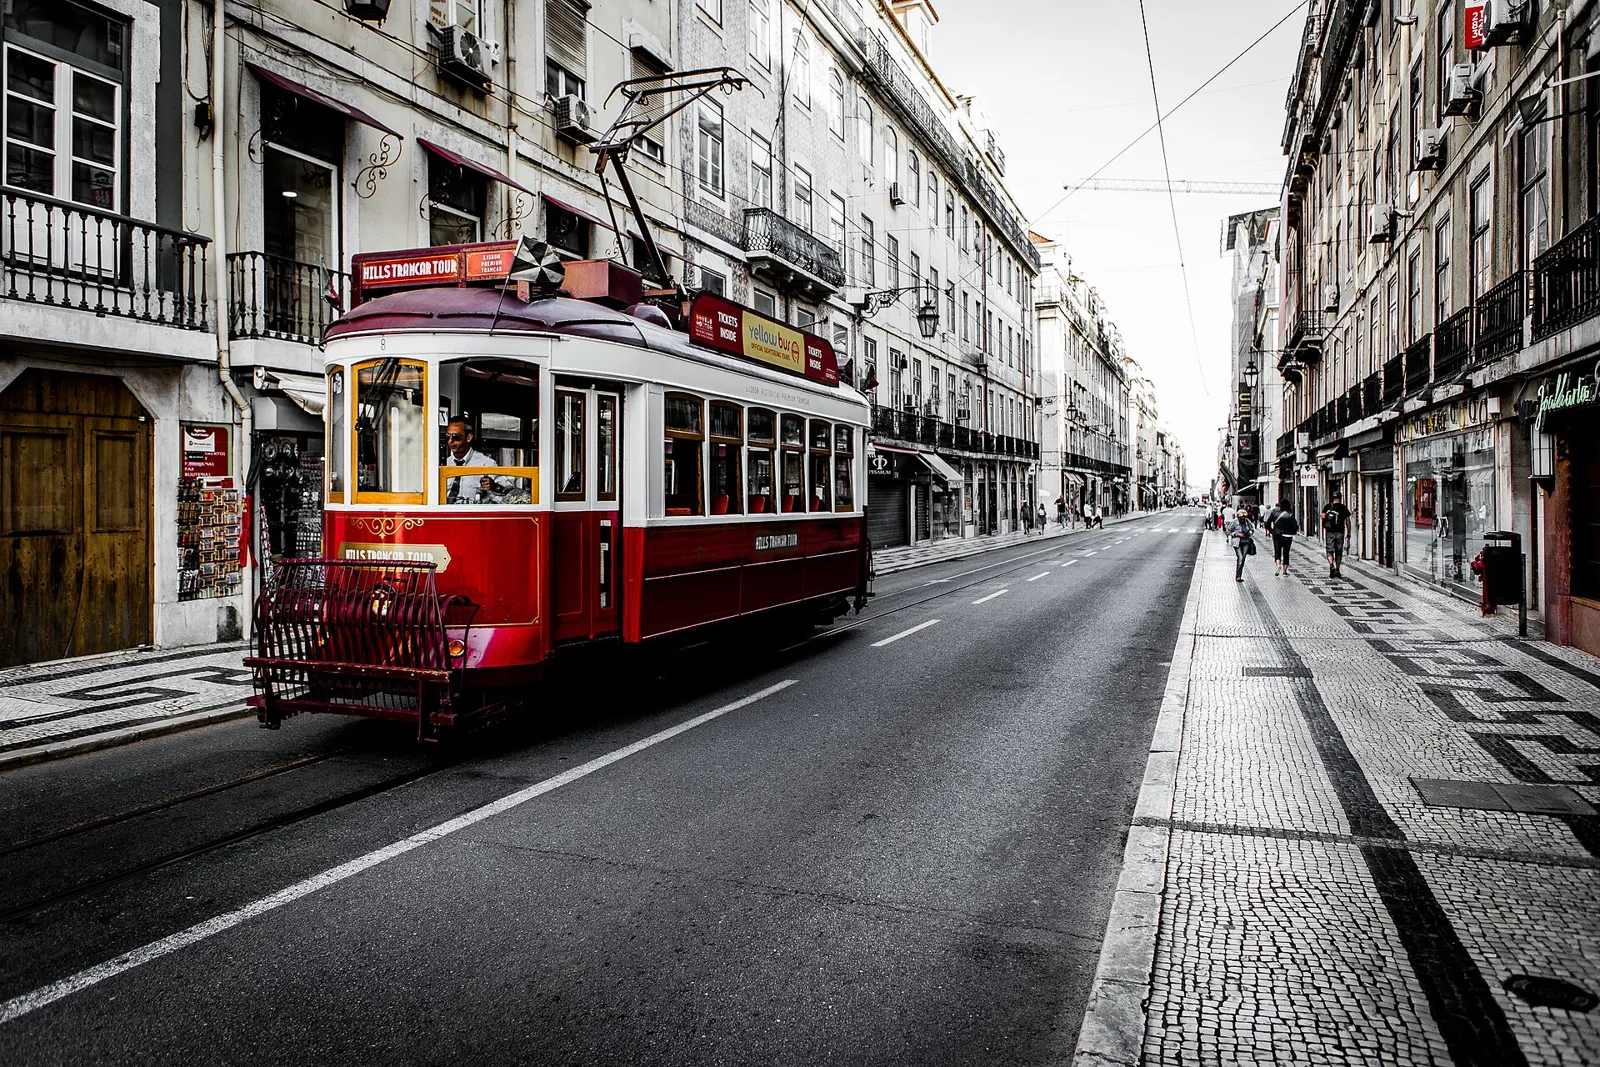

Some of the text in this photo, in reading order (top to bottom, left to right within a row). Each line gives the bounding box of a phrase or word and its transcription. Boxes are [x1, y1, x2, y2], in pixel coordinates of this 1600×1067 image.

[363, 259, 457, 280] HILLS TRAMCAR TOUR
[718, 311, 738, 328] TICKETS
[720, 327, 737, 342] INSIDE
[749, 324, 791, 351] yellow bus
[381, 338, 386, 351] 8
[751, 343, 764, 352] OFFICIAL
[808, 345, 822, 359] TICKETS
[810, 359, 822, 370] INSIDE
[746, 385, 759, 394] LISBON
[756, 536, 768, 550] HILLS
[788, 534, 798, 546] TOUR
